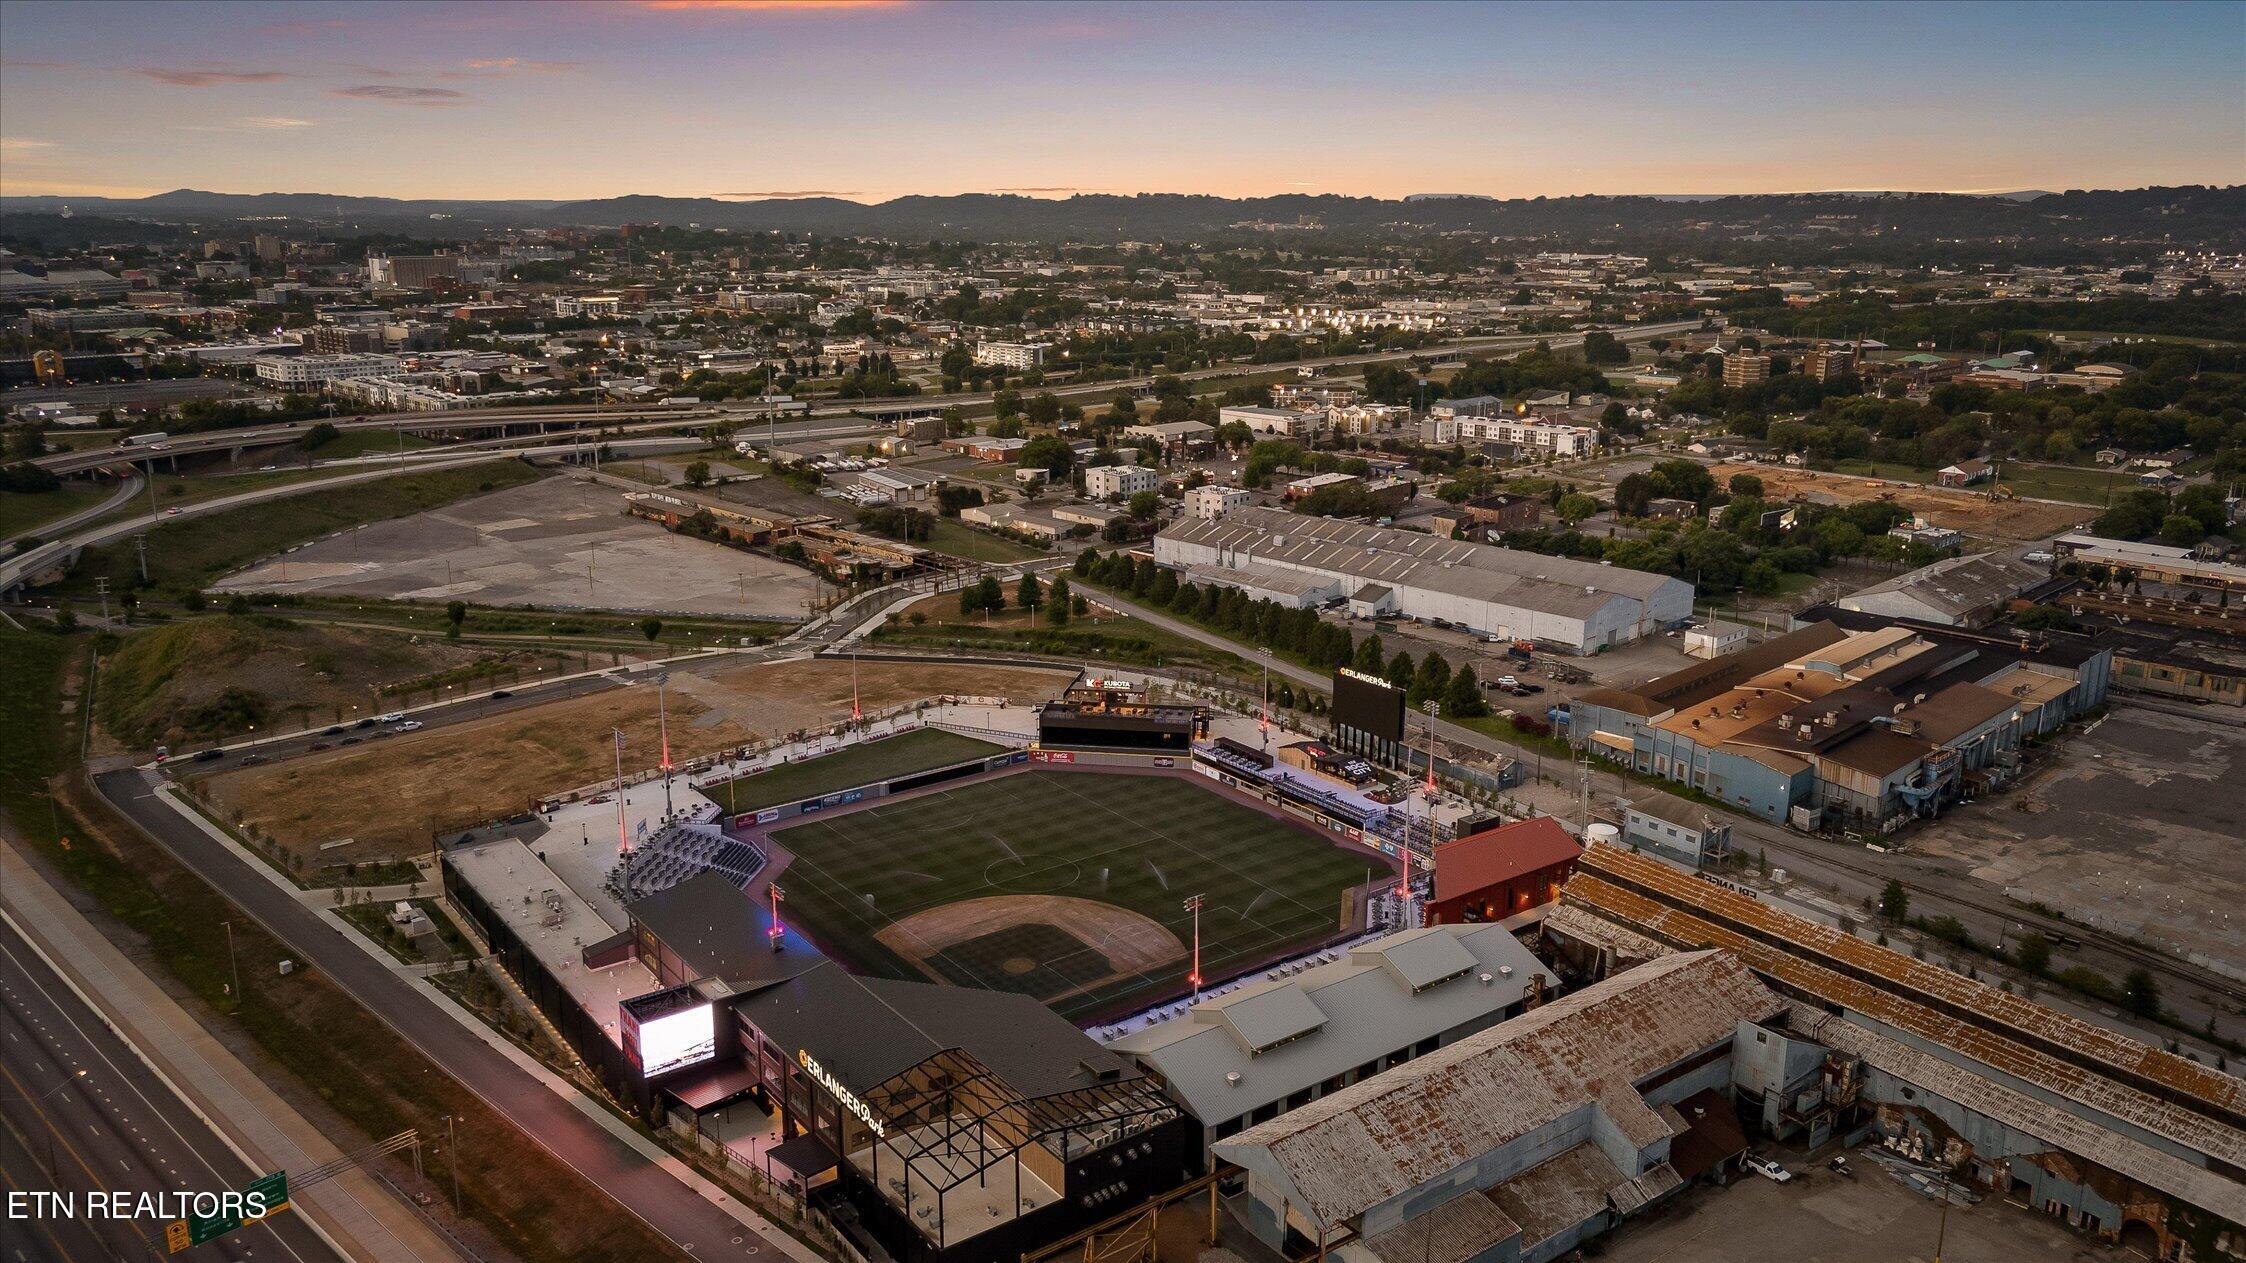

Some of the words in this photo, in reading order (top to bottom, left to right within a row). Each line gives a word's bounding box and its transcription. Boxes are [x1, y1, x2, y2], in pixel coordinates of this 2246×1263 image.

[1345, 669, 1378, 684] ERLANGER
[1377, 677, 1392, 689] Park
[1344, 761, 1369, 772] ROCK
[1353, 766, 1372, 776] CITY
[807, 1055, 862, 1117] ERLANGER
[861, 1103, 886, 1138] Park
